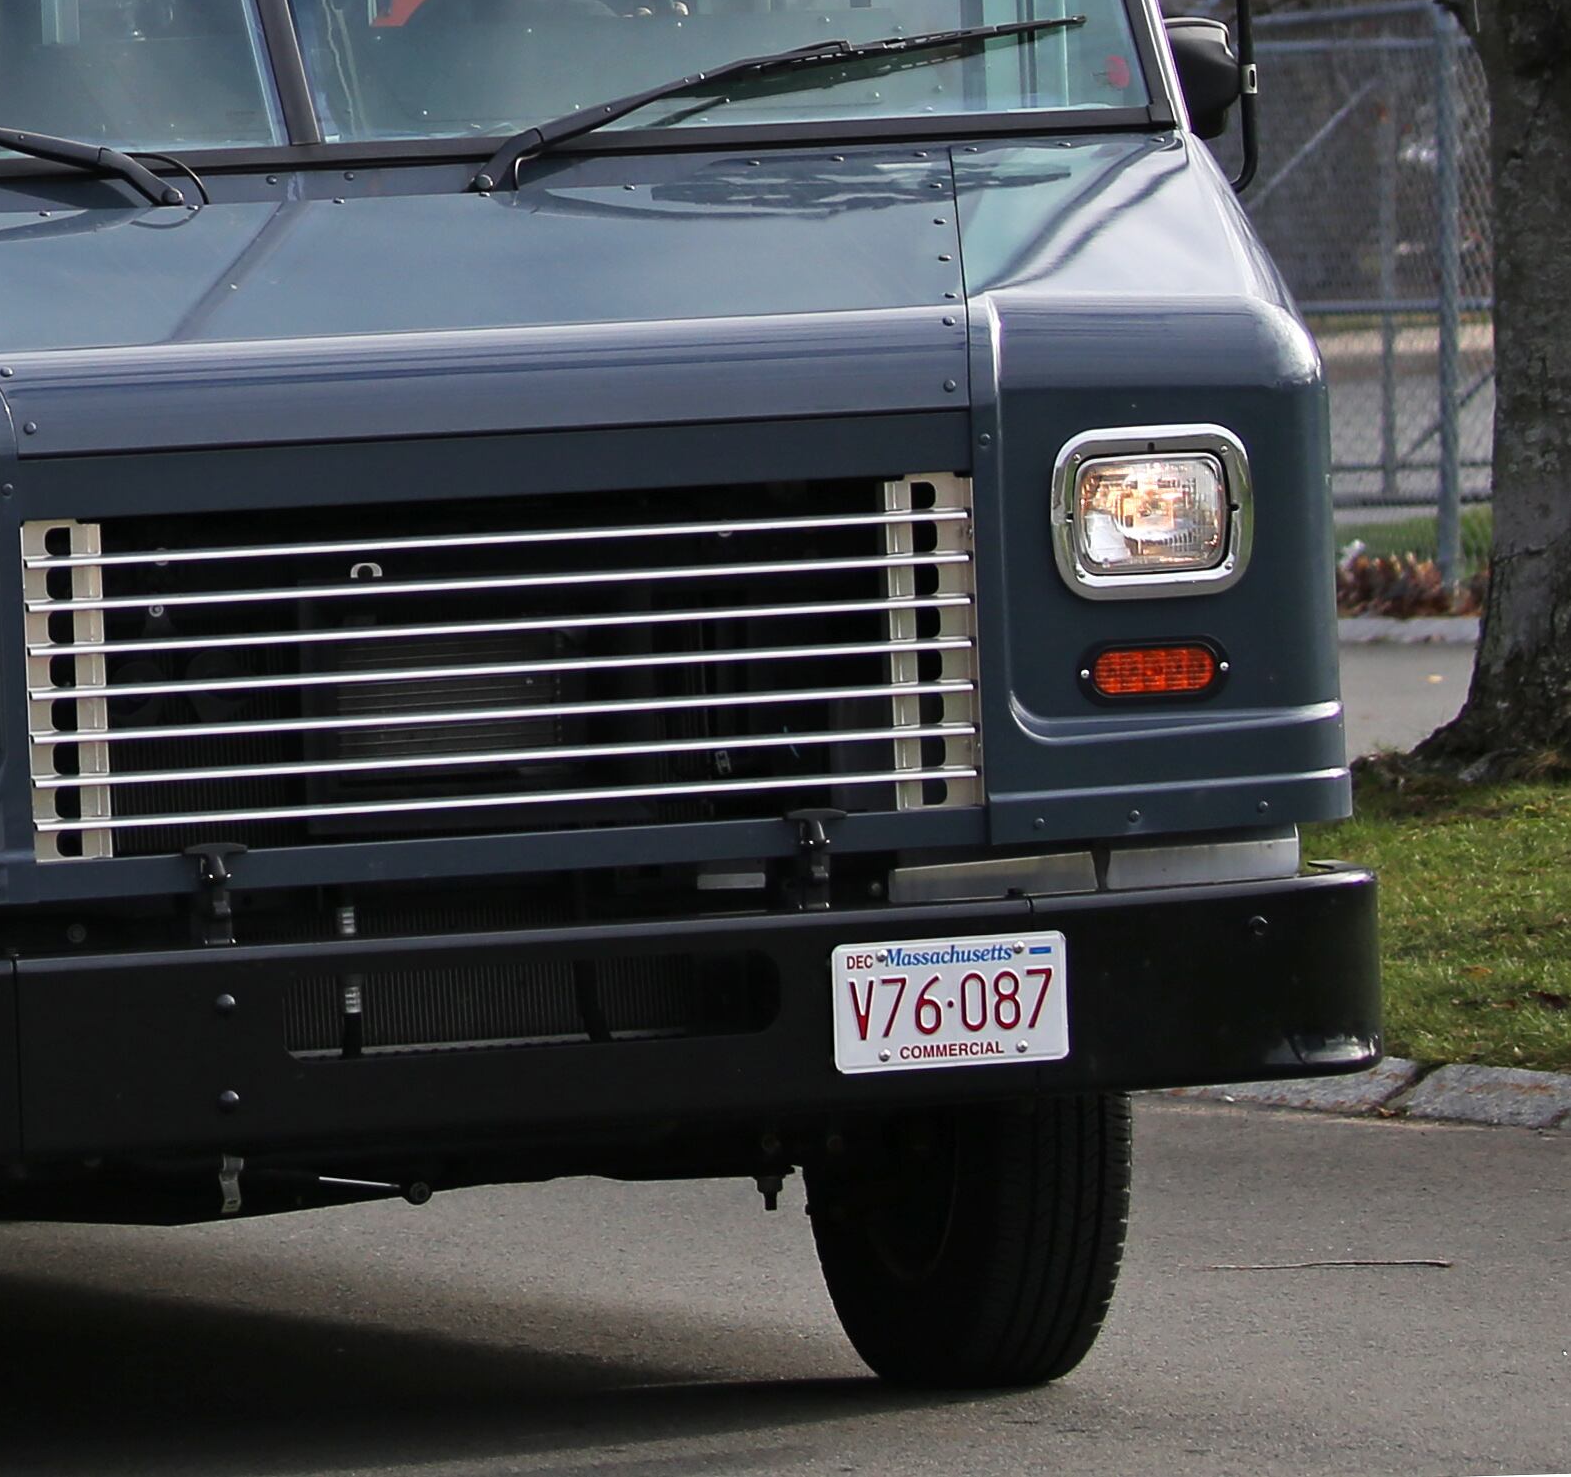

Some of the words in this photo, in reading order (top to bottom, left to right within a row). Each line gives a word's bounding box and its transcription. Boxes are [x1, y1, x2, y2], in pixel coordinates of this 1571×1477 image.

[846, 955, 873, 970] DEC
[885, 944, 1013, 968] Massachusetts
[900, 1041, 1005, 1060] COMMERCIAL
